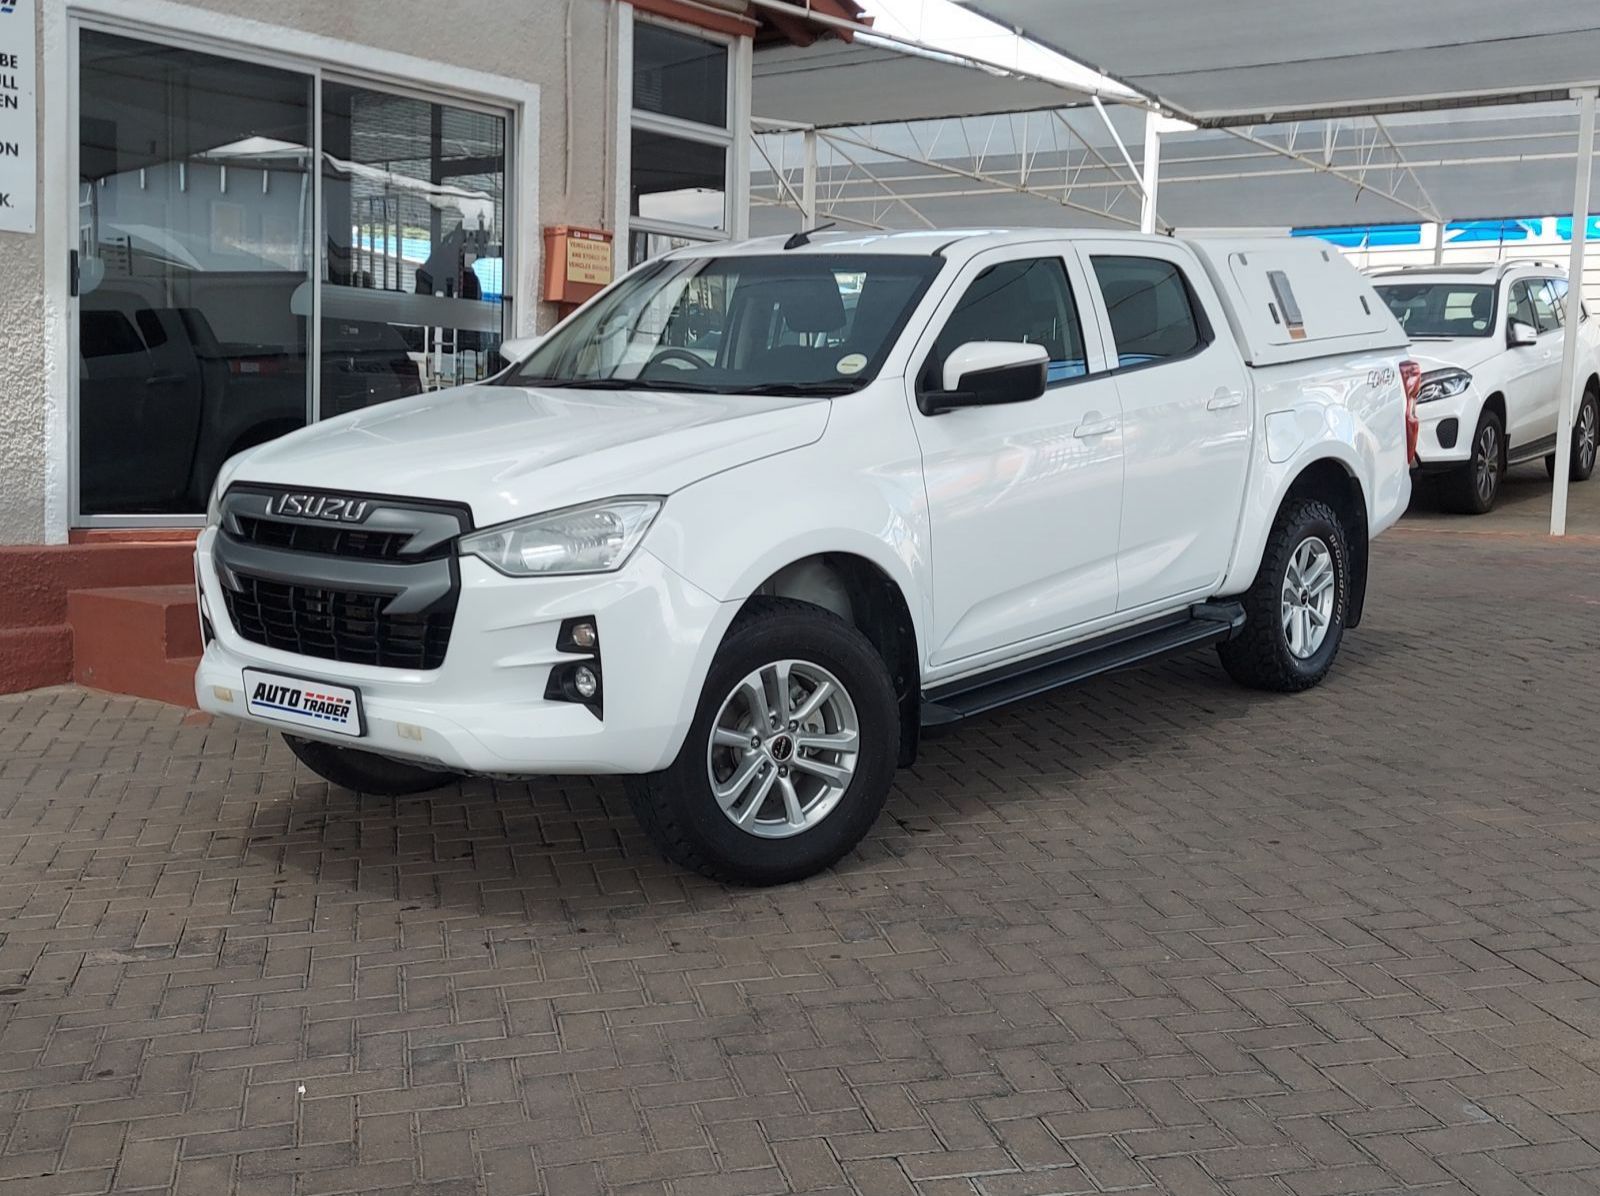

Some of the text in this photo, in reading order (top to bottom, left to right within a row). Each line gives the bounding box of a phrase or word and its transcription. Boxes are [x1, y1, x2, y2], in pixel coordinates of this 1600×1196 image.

[0, 53, 18, 69] BE
[0, 73, 18, 90] LL
[277, 494, 367, 521] ISUZU
[252, 682, 350, 718] AUTO TRADER
